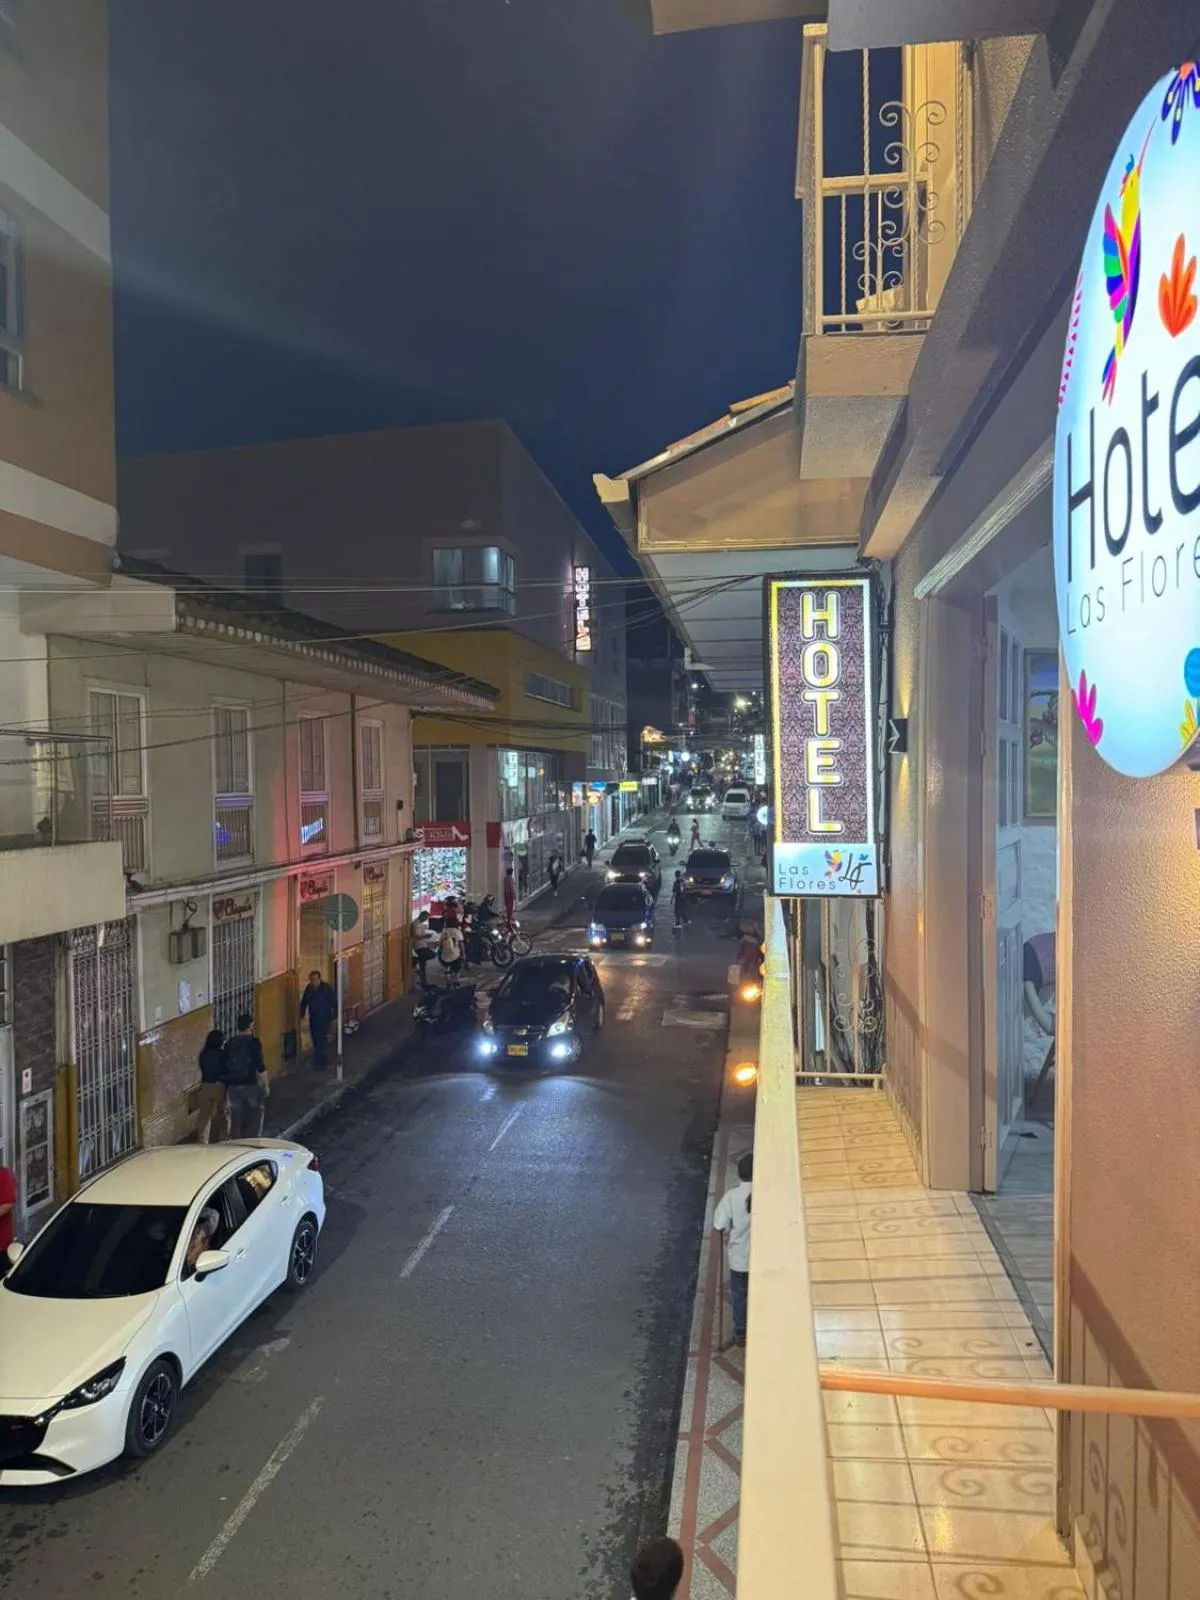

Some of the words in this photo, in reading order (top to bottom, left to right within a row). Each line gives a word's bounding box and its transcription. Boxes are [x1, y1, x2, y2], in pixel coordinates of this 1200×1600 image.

[1066, 585, 1106, 634] Las
[801, 591, 844, 833] HOTEL
[778, 863, 809, 876] Las
[778, 877, 836, 890] Flores
